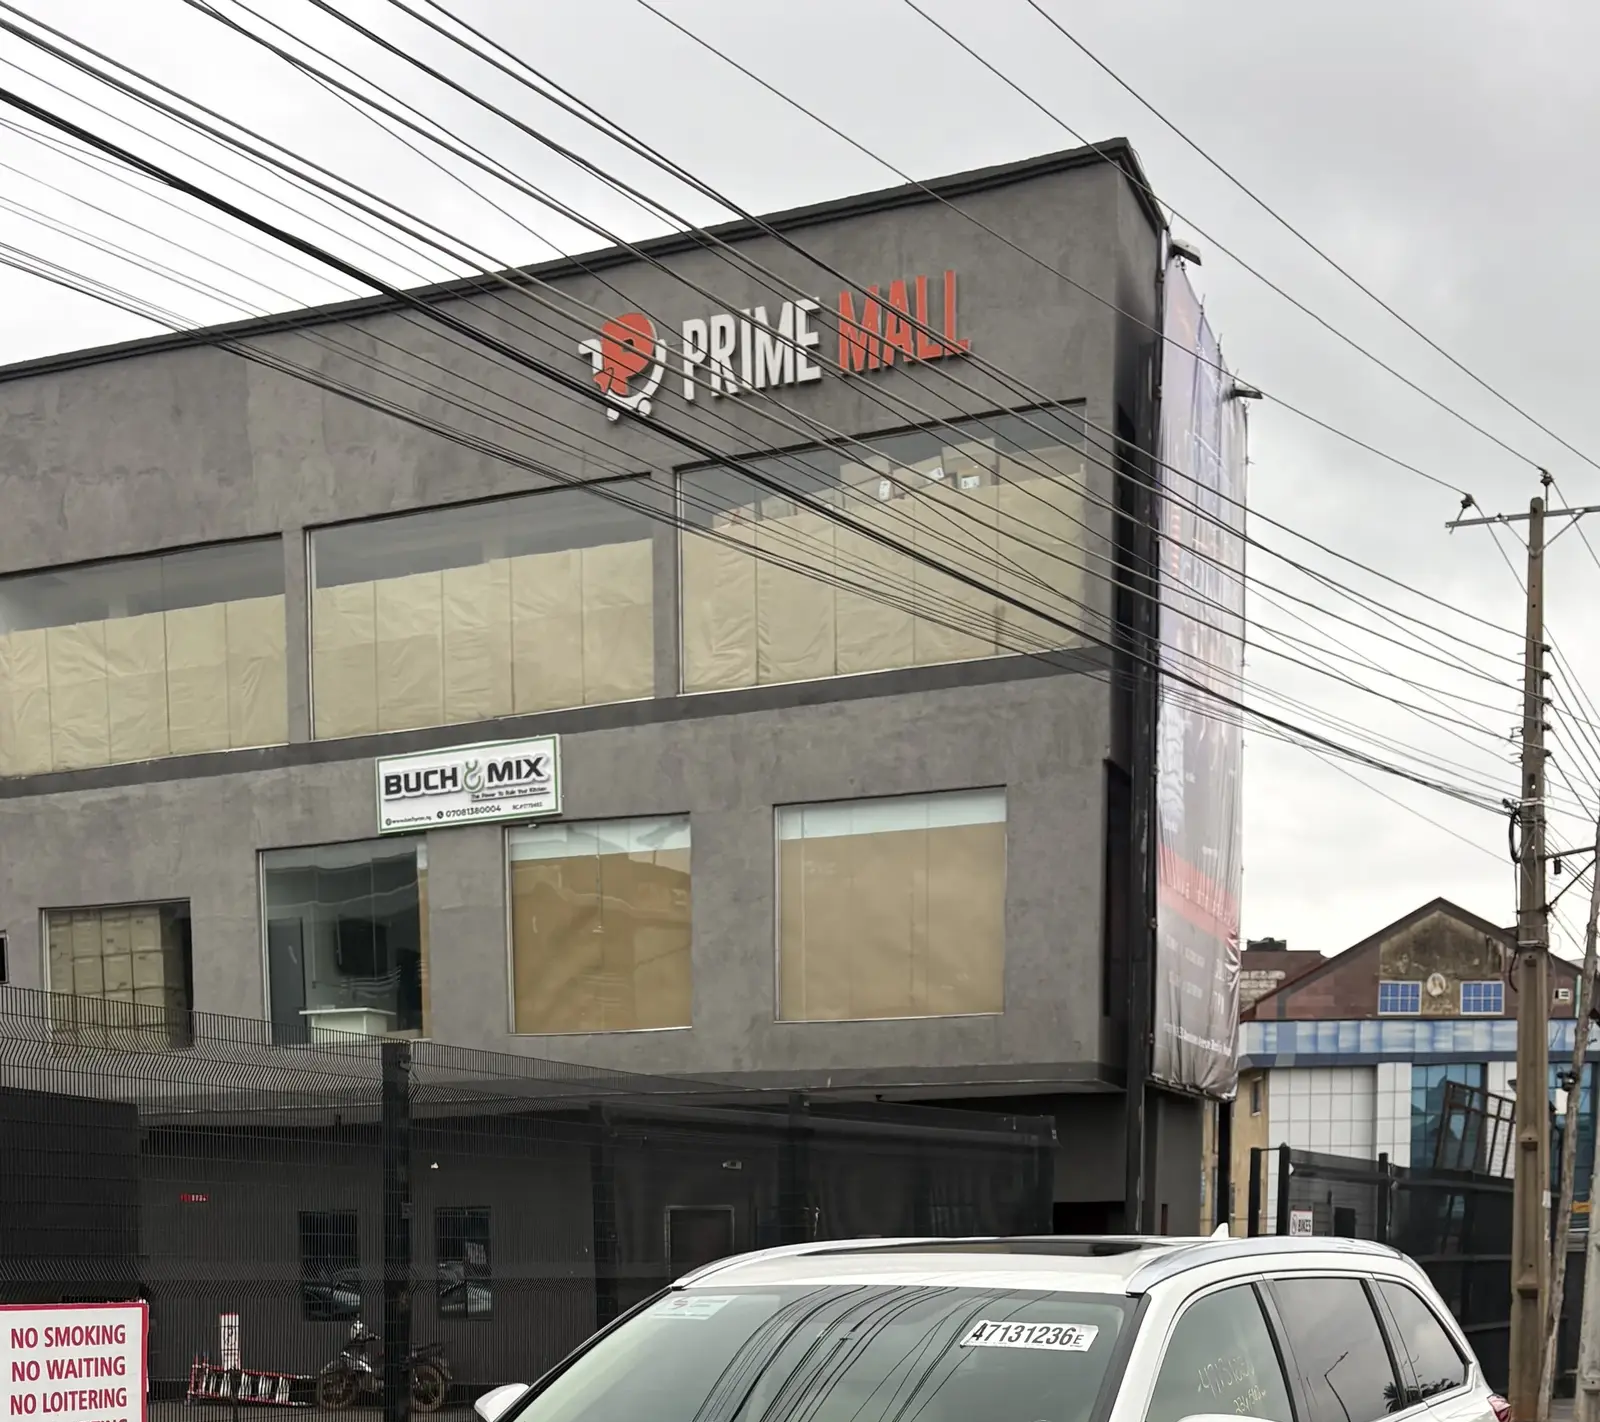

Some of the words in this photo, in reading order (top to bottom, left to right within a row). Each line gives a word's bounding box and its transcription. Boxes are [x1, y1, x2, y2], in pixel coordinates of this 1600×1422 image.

[682, 296, 823, 401] PRIME
[838, 270, 971, 375] MALL
[487, 756, 544, 783] MIX
[11, 1327, 39, 1349] NO
[44, 1324, 126, 1348] SMOKING
[11, 1360, 41, 1383] NO
[46, 1356, 126, 1380] WAITING
[10, 1393, 37, 1416] NO
[42, 1387, 127, 1413] LOITERING
